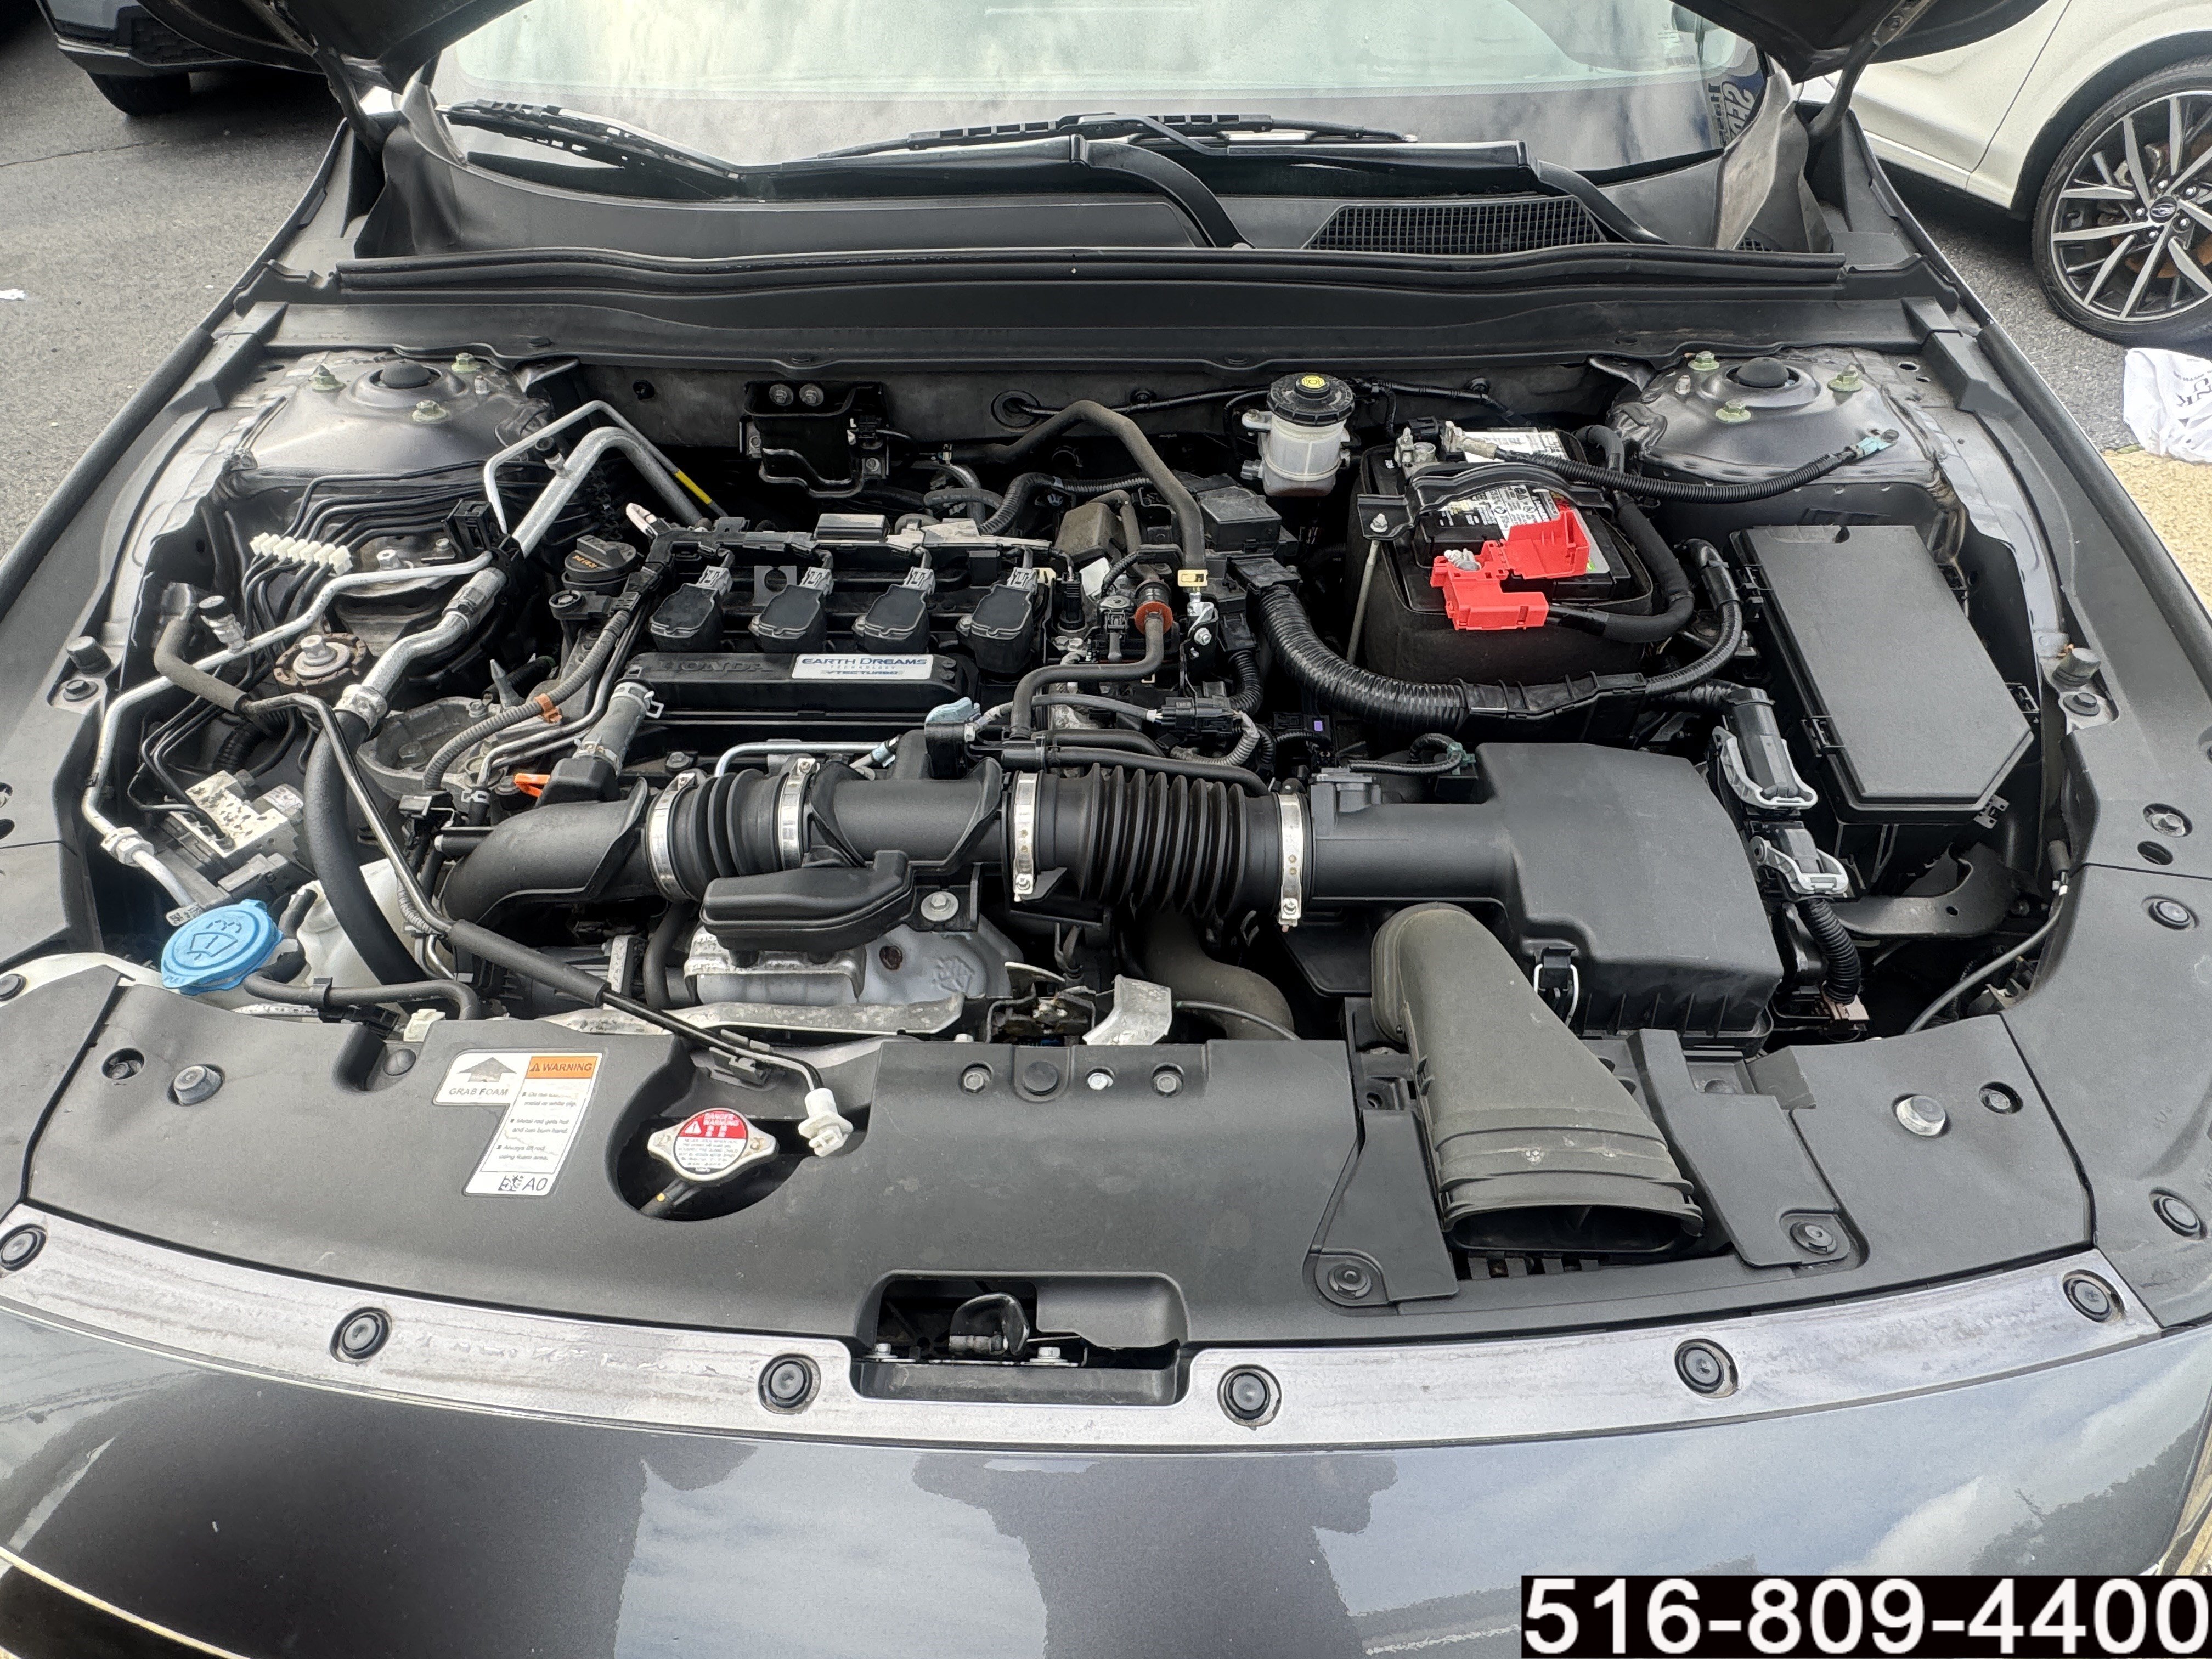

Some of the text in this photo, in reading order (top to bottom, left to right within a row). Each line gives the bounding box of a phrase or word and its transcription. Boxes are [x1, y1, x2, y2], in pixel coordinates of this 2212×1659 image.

[654, 660, 772, 673] HONDA
[542, 1062, 592, 1072] WARNING
[449, 1087, 509, 1096] GRAB FOAM
